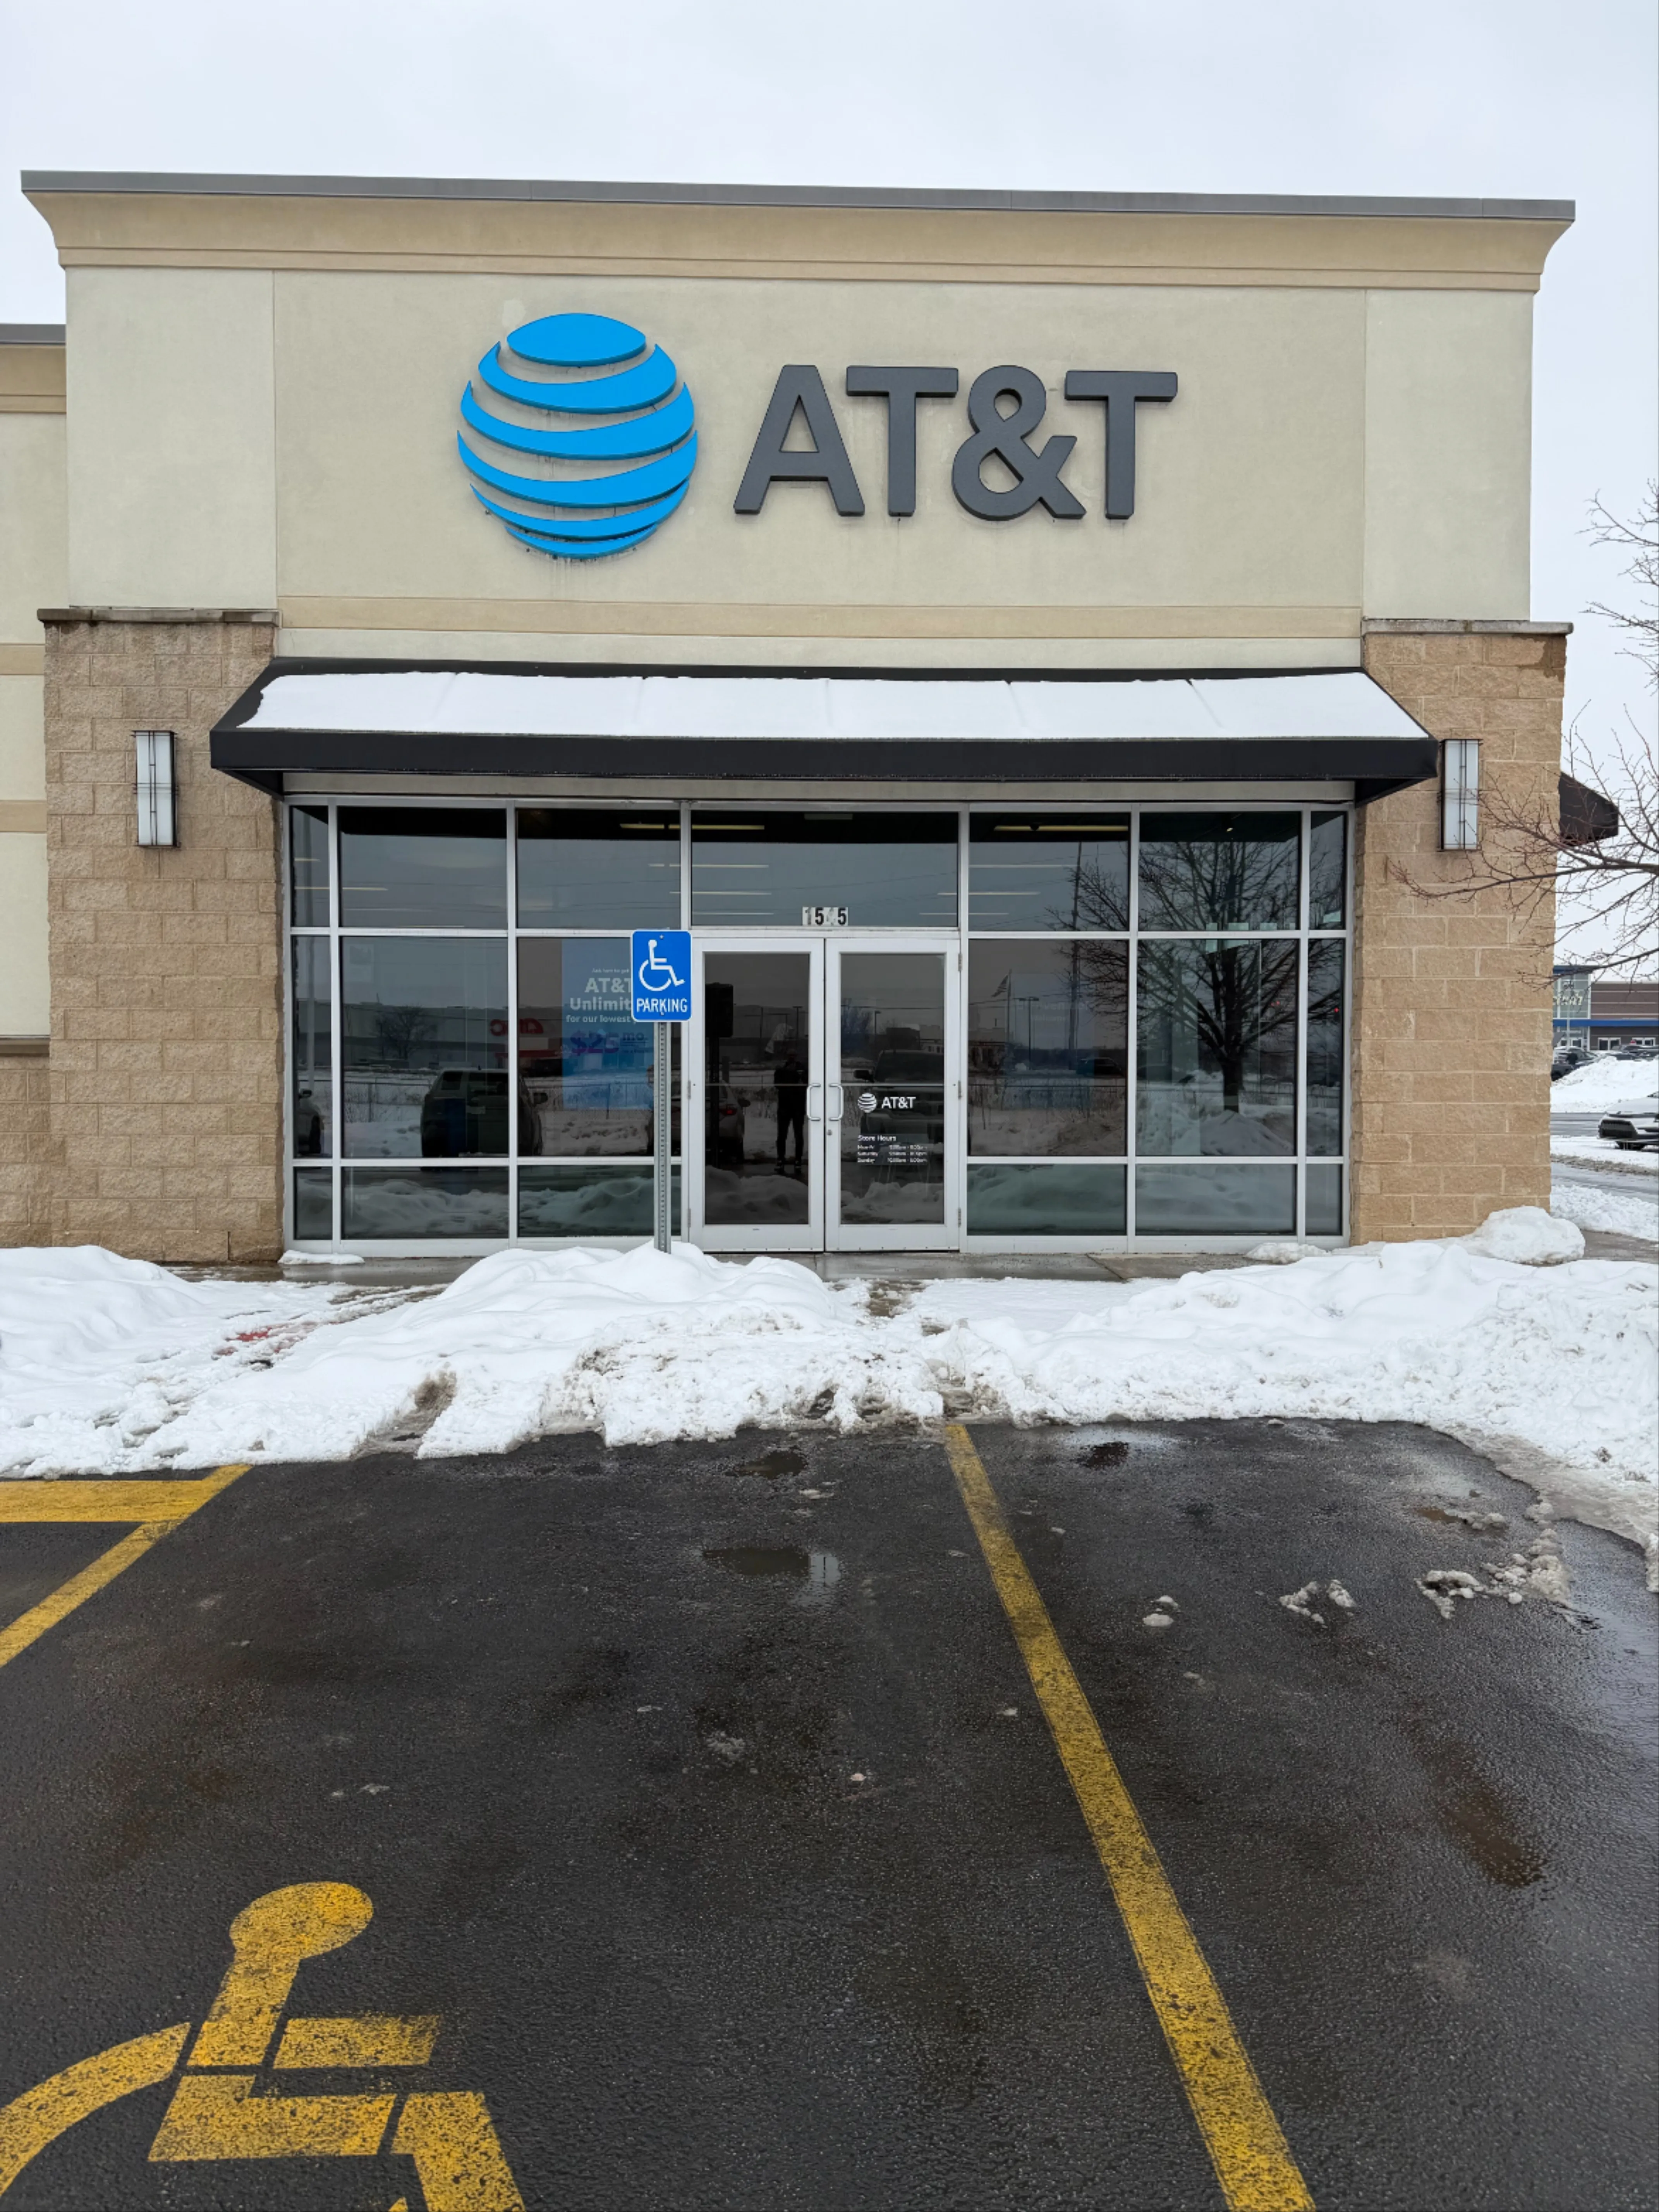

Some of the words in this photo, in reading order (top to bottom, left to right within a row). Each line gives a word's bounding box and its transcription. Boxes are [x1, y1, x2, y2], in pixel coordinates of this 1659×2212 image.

[734, 365, 1178, 520] AT&T
[570, 996, 632, 1011] Unlimit
[637, 998, 688, 1013] PARKING
[570, 1029, 618, 1056] $25
[623, 1032, 648, 1041] mo.
[881, 1097, 916, 1109] AT&T
